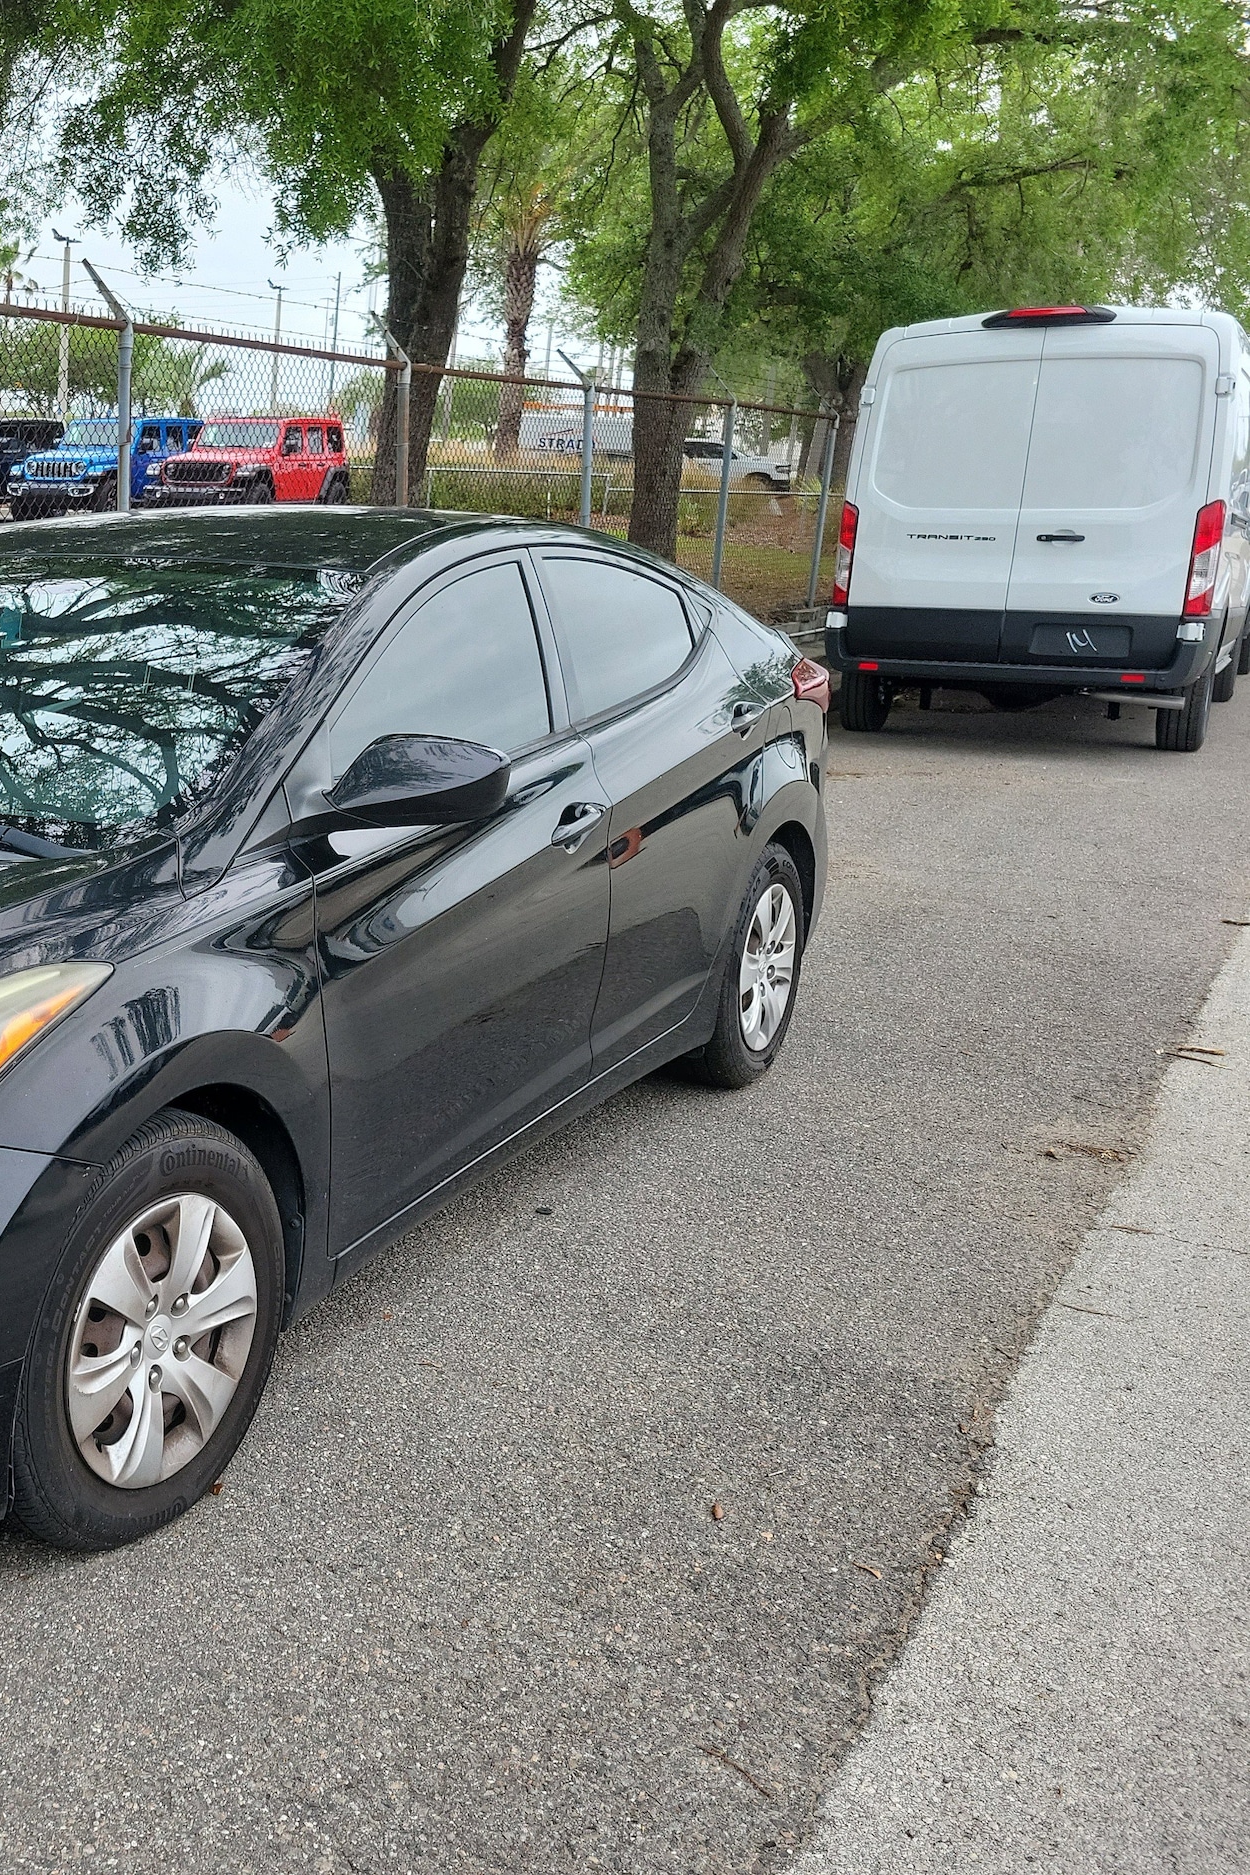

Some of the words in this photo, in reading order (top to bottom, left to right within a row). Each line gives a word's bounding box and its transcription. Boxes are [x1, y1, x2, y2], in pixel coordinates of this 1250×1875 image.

[538, 437, 596, 450] STRAD
[906, 533, 974, 541] TRANSIT
[1065, 628, 1098, 653] 14
[158, 1143, 241, 1178] Continental
